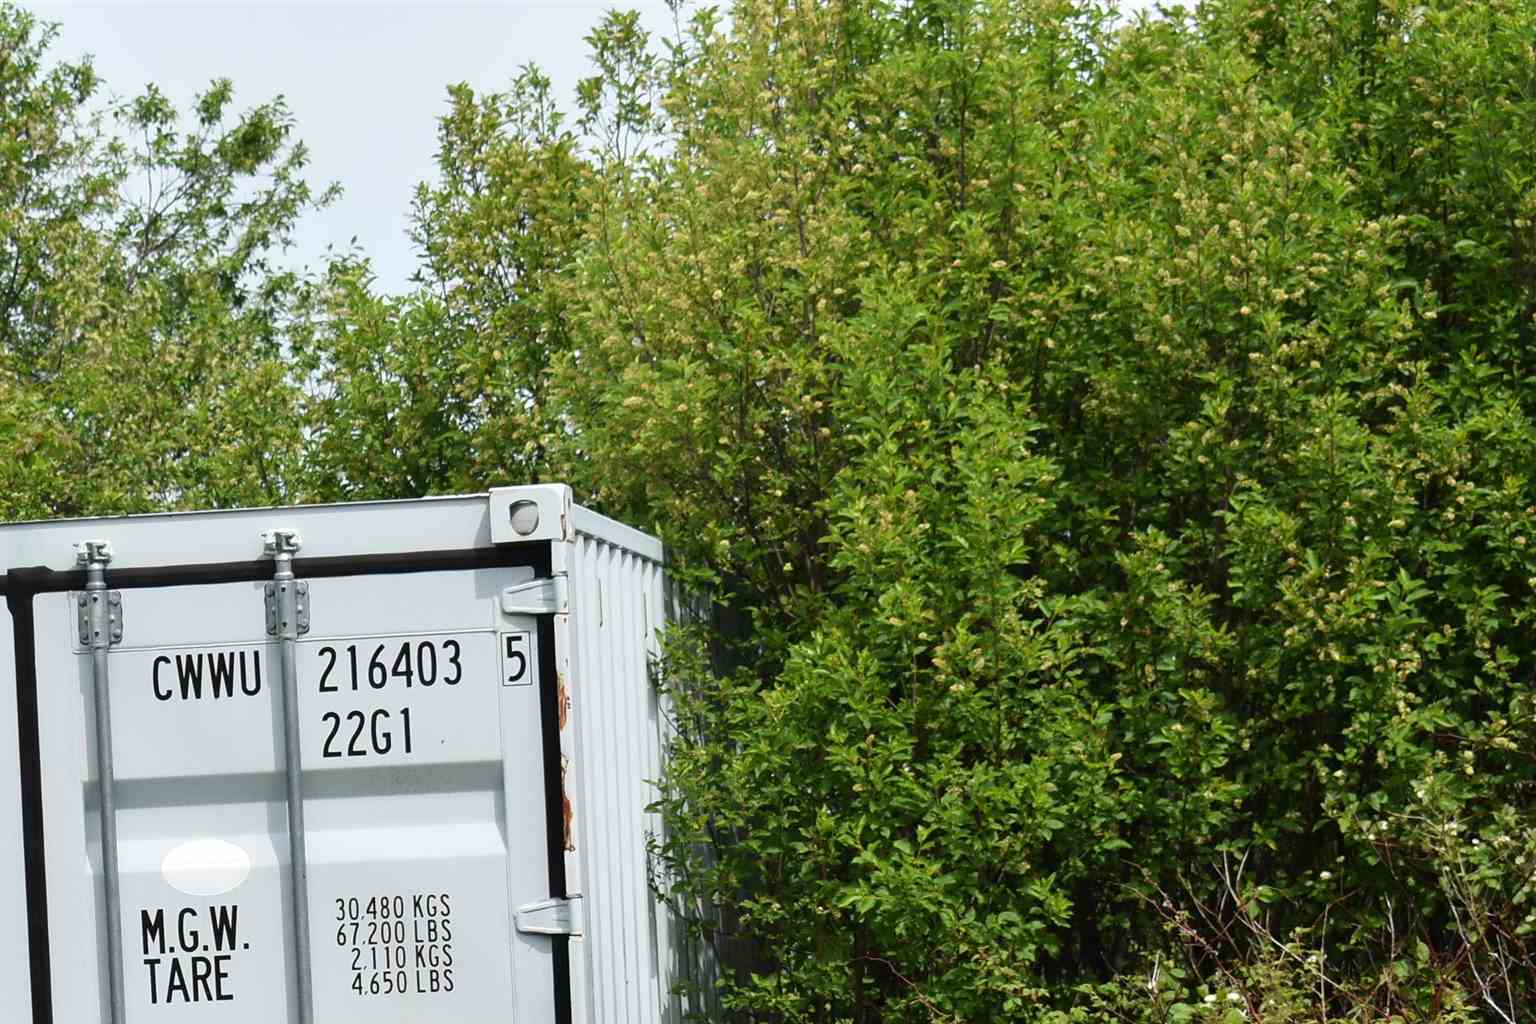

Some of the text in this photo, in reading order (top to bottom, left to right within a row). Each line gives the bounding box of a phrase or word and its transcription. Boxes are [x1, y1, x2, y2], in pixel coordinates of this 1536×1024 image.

[152, 635, 527, 701] CWWU 216403 5
[321, 707, 412, 758] 22G1
[335, 894, 451, 921] 30,480 KGS
[140, 904, 250, 955] M.G.W.
[336, 918, 452, 946] 67,200 LBS
[351, 943, 453, 971] 2,110 KGS
[143, 954, 234, 1005] TARE
[351, 968, 454, 996] 4,650 LBS
